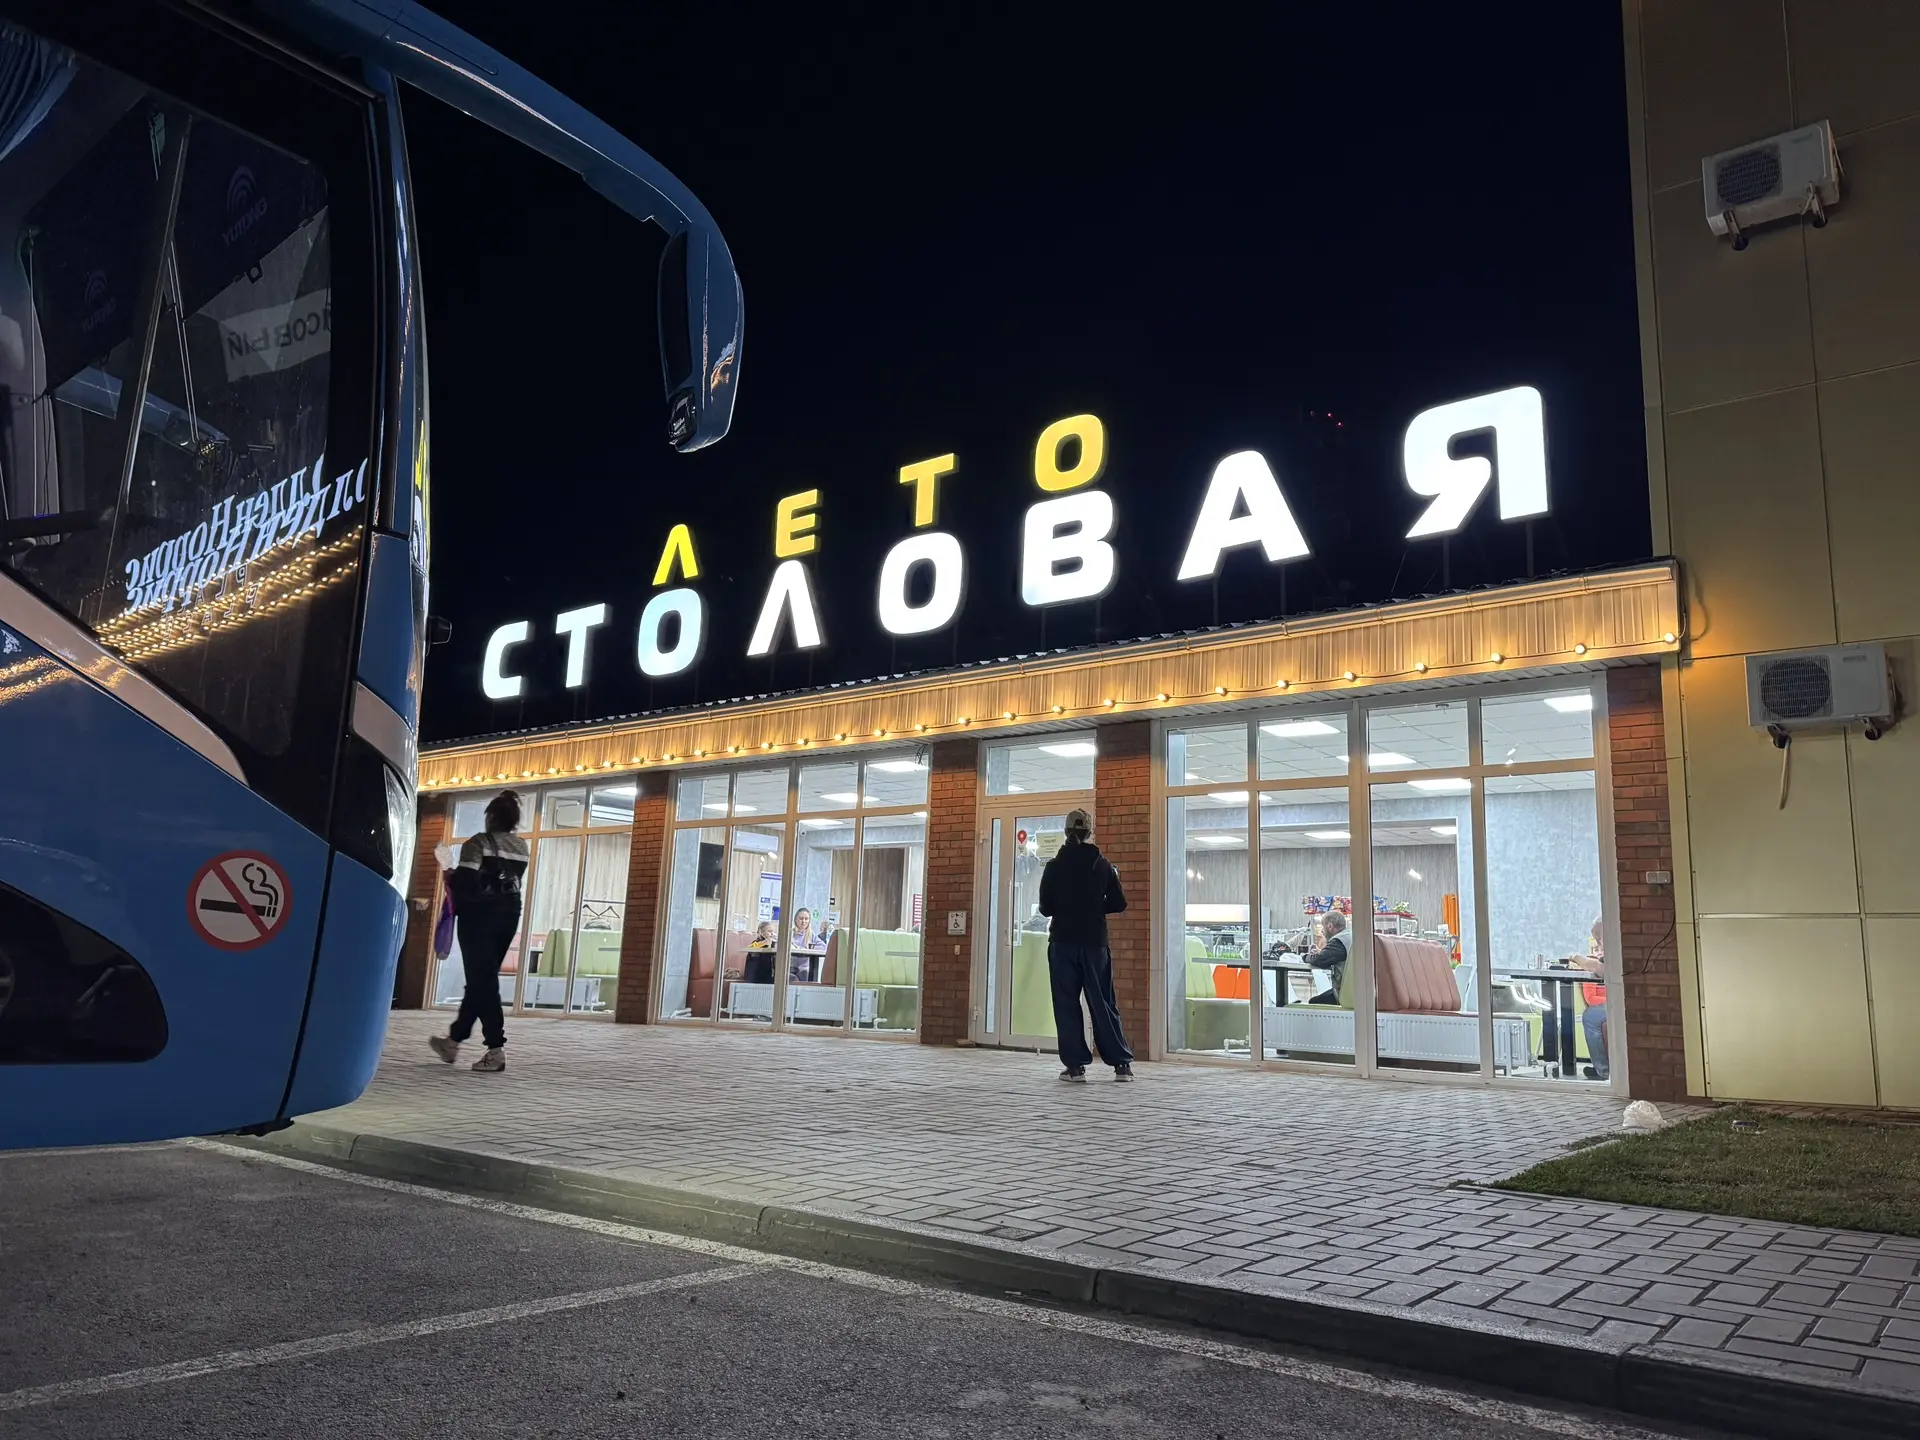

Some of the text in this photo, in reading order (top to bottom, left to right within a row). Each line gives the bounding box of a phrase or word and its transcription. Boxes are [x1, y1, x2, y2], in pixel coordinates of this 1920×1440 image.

[221, 196, 268, 248] YUTONG
[482, 385, 1551, 699] СТОЛОВАЯ
[652, 413, 1106, 586] ЛЕТО
